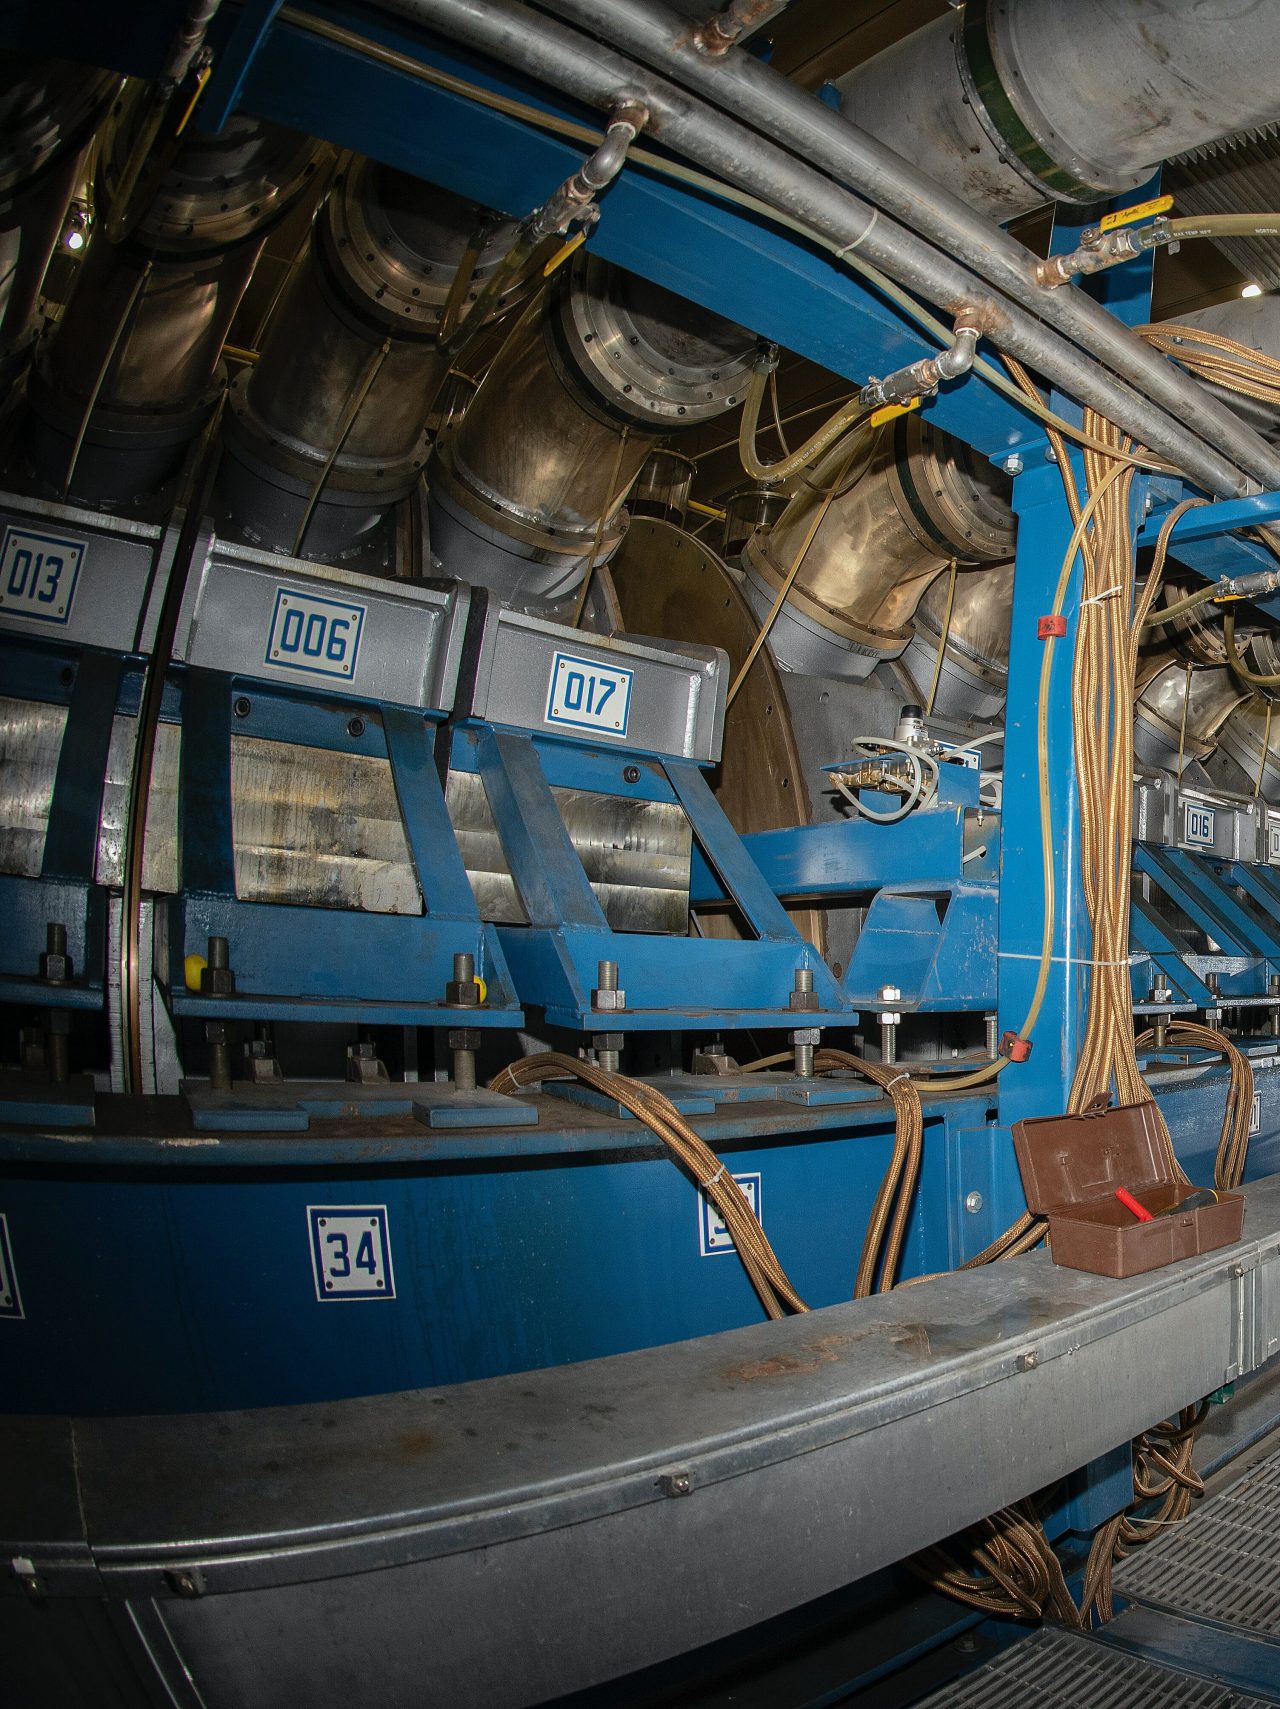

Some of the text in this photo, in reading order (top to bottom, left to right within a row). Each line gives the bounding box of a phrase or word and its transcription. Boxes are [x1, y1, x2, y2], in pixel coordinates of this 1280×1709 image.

[7, 549, 64, 604] 013
[280, 608, 350, 662] 006
[564, 671, 617, 716] 017
[326, 1230, 377, 1278] 34
